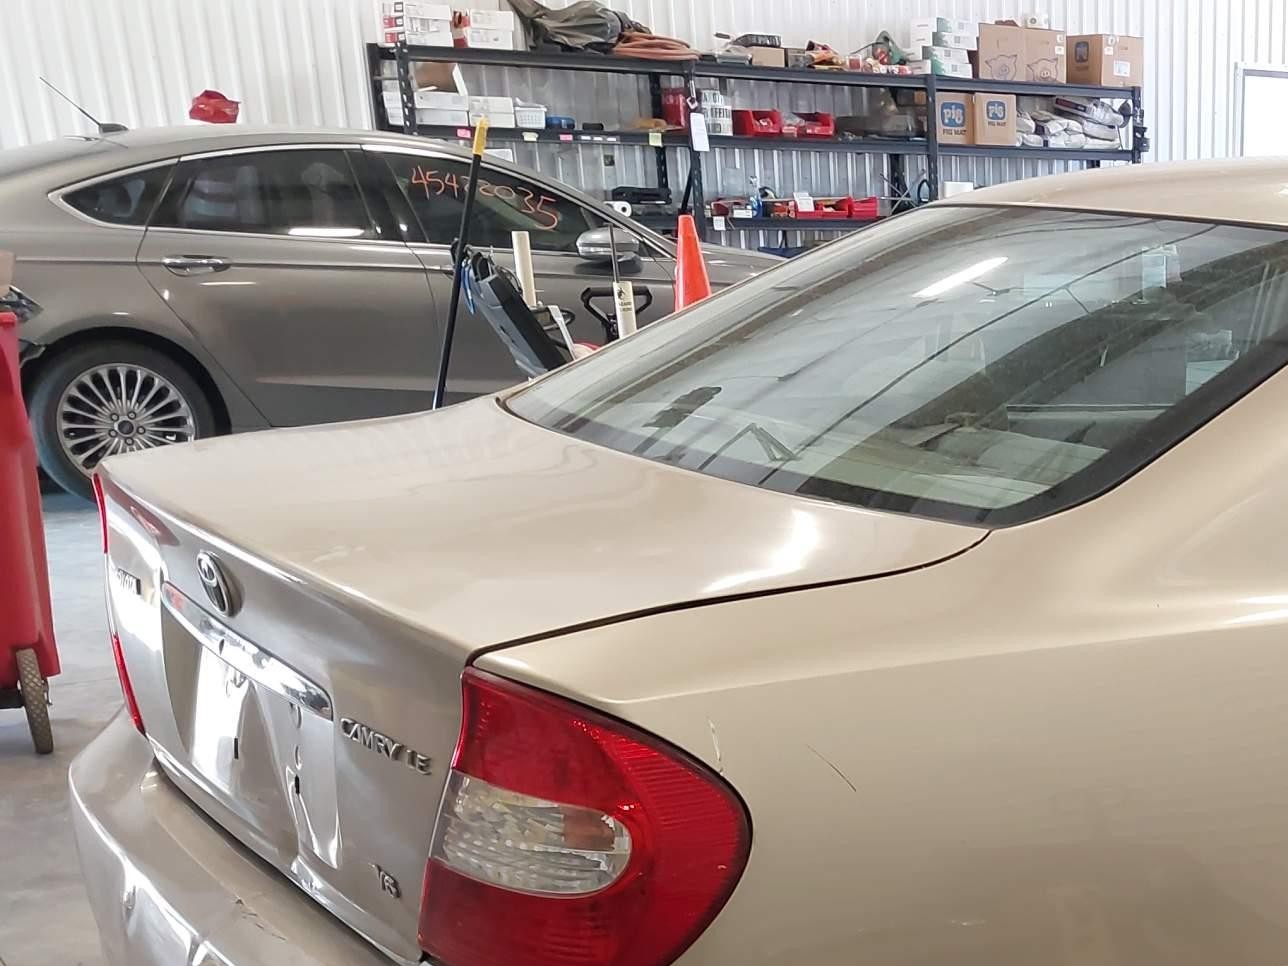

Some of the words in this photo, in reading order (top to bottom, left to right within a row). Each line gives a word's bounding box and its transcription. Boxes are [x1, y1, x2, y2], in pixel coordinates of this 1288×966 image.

[340, 717, 404, 761] CAMRY
[406, 748, 433, 776] LE
[370, 863, 401, 898] V6
